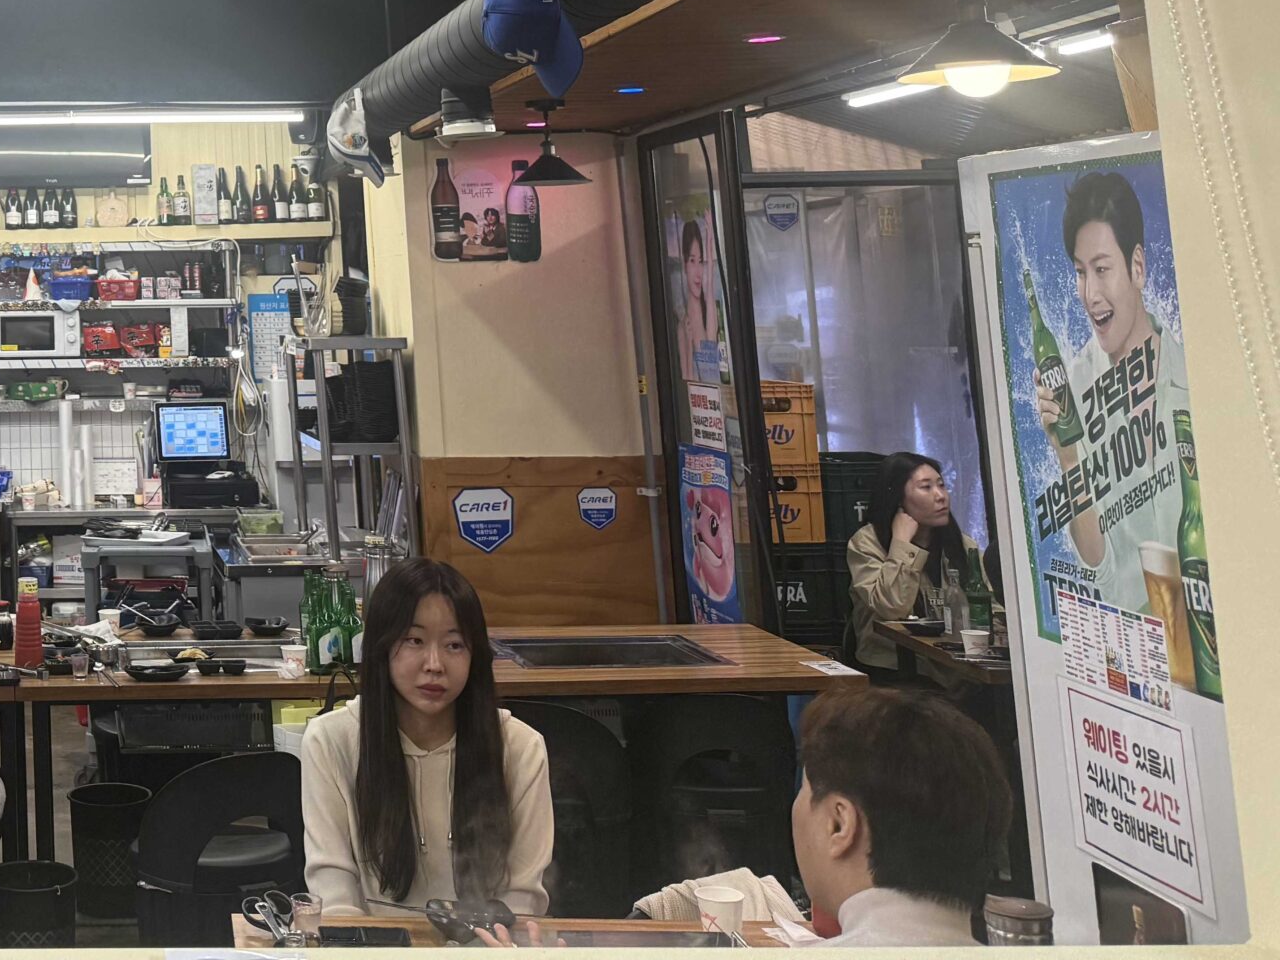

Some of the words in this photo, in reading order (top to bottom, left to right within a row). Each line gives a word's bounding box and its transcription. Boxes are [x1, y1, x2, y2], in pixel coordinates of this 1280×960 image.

[1082, 336, 1157, 444] 강력한
[765, 424, 795, 445] elly
[1035, 443, 1111, 542] 리얼탄산
[1110, 400, 1167, 483] 100%
[1122, 461, 1176, 515] 청정라거다!
[459, 500, 508, 513] CARE1
[580, 496, 614, 504] CARE1
[770, 504, 801, 524] elly
[1181, 575, 1213, 613] TER
[1082, 717, 1129, 764] 웨이팅
[1132, 742, 1176, 784] 있을시
[1087, 760, 1136, 806] 식사시간
[1141, 786, 1181, 825] 2시간
[1084, 793, 1108, 825] 제한
[1111, 806, 1194, 868] 양해바랍니다
